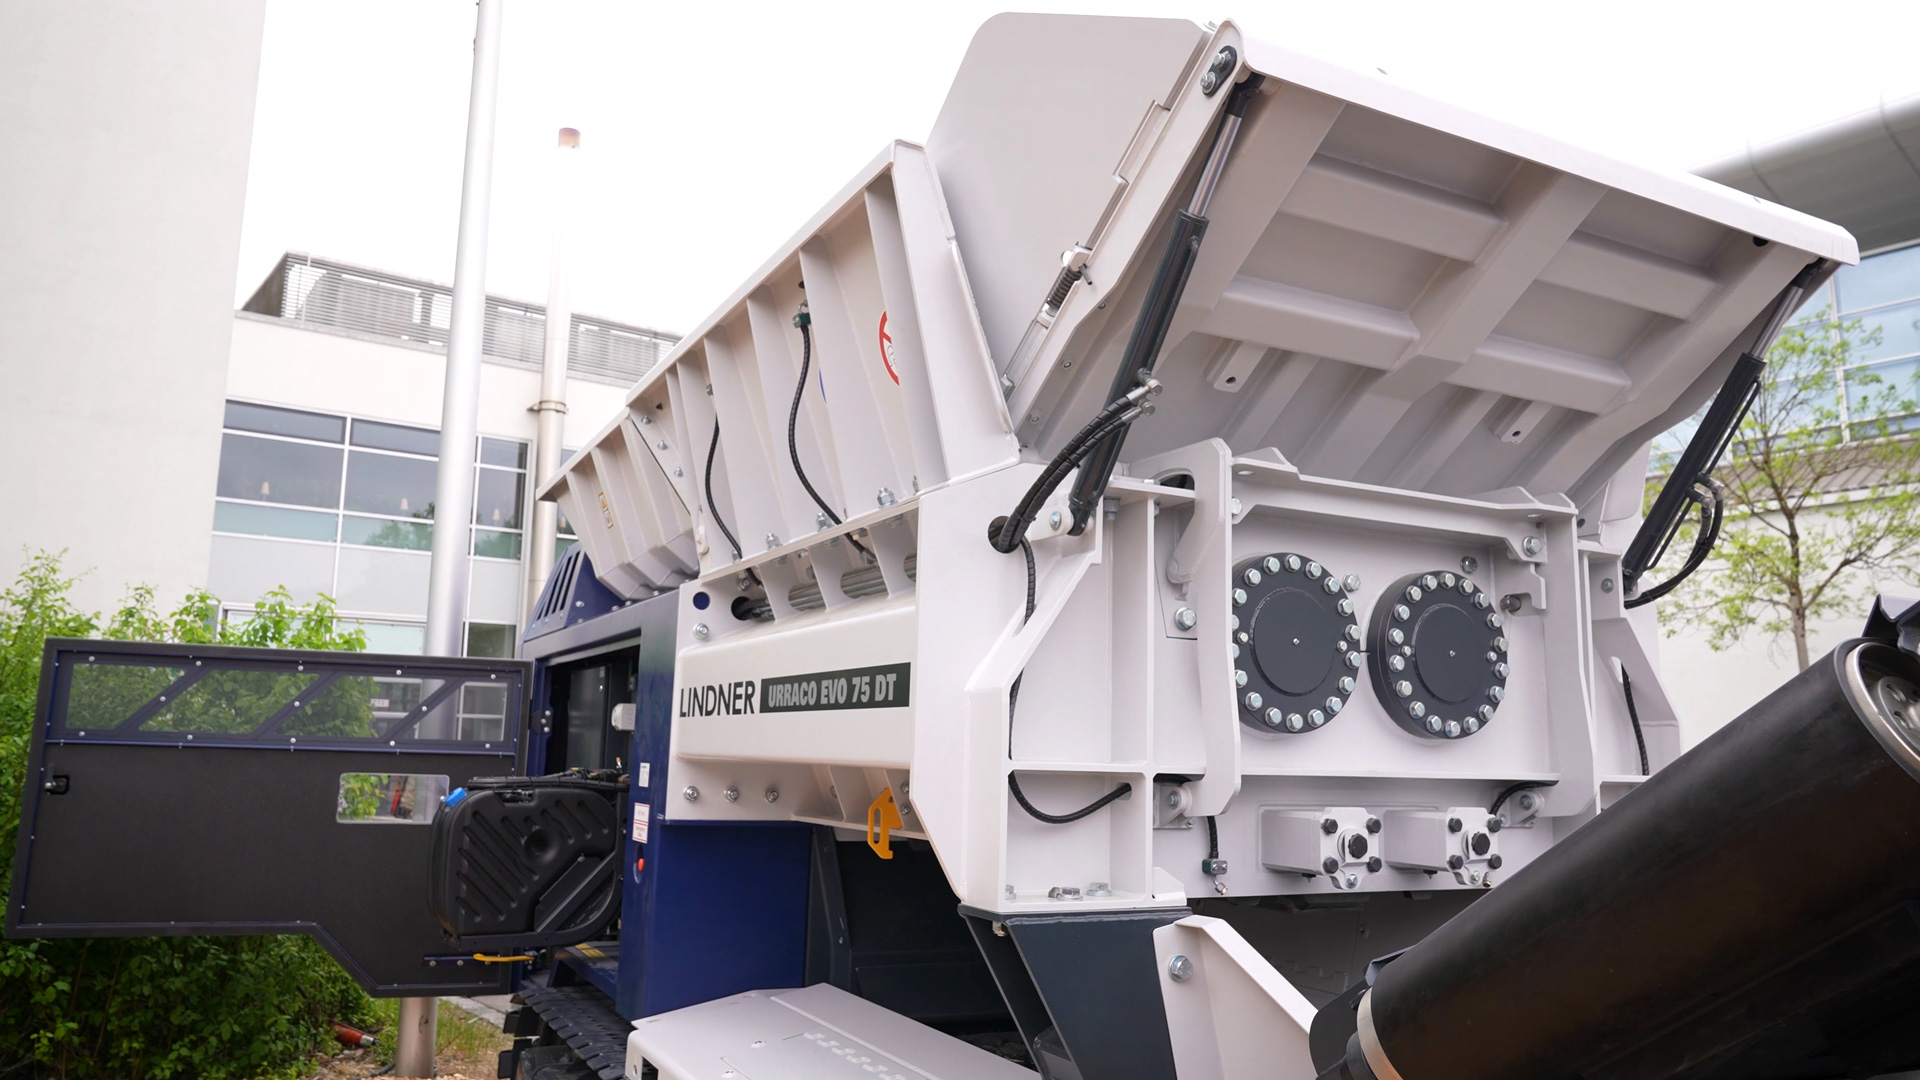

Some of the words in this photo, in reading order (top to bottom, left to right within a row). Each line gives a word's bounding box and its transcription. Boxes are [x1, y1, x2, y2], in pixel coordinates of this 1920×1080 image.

[680, 681, 755, 717] LINDNER
[768, 680, 817, 707] URRACO
[820, 678, 847, 704] EVO
[852, 676, 870, 703] 75
[875, 673, 896, 701] DT
